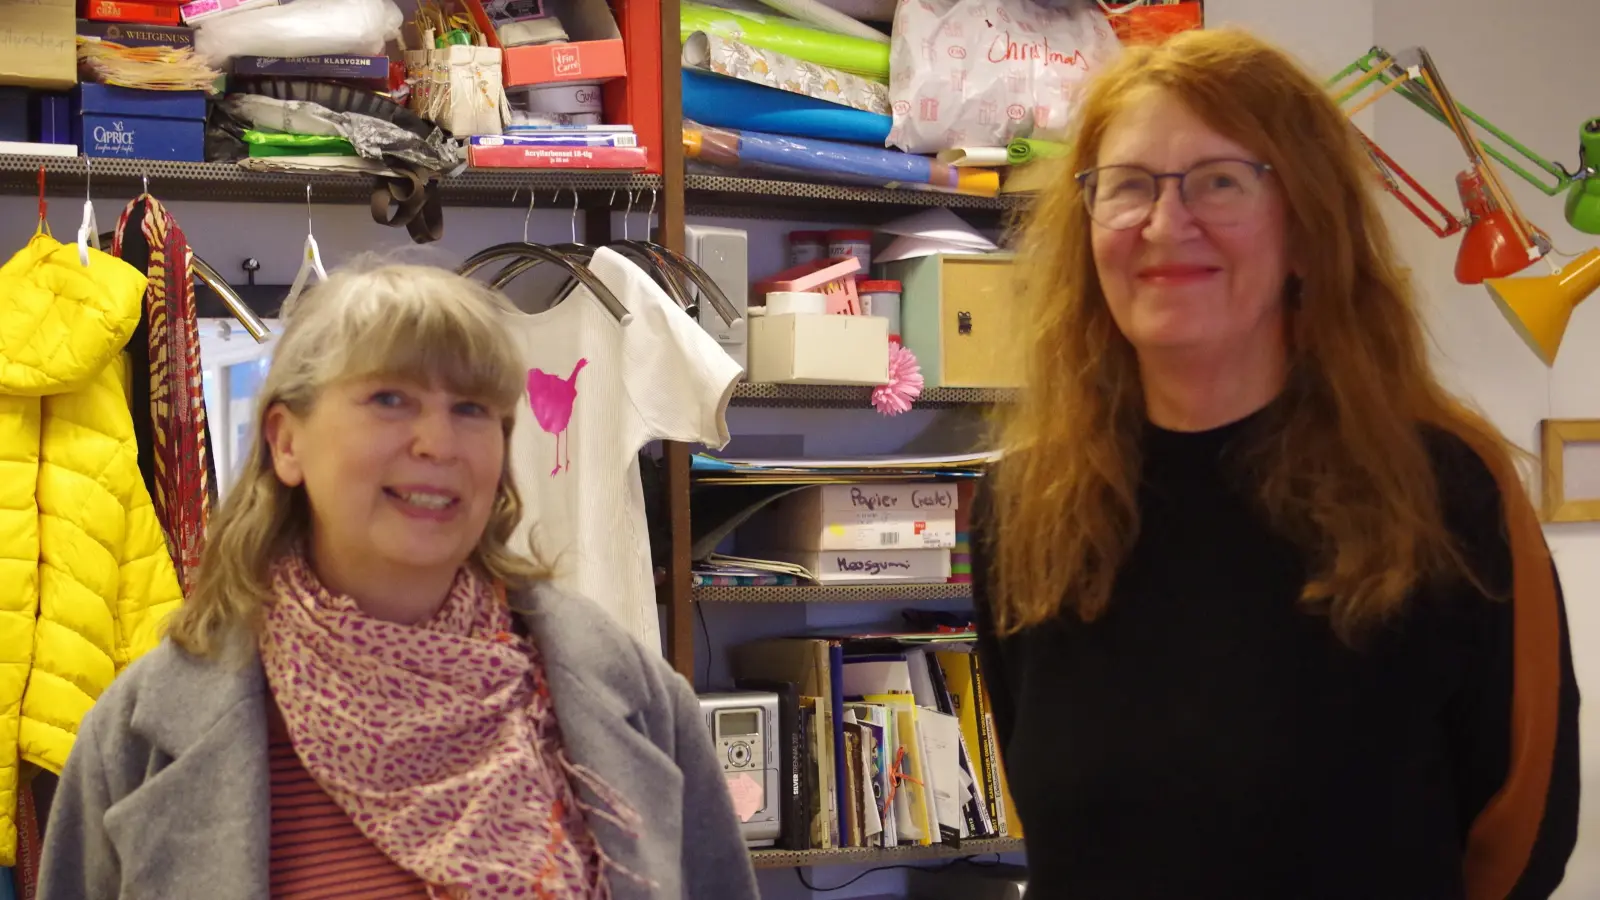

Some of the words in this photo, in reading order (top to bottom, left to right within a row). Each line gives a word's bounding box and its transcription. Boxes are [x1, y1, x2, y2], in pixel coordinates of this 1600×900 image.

[126, 31, 190, 43] WELTGENUSS
[988, 31, 1089, 71] Christmas
[324, 58, 371, 66] KLASYCZNE
[93, 126, 134, 145] CAPRICE
[850, 486, 898, 510] Papier
